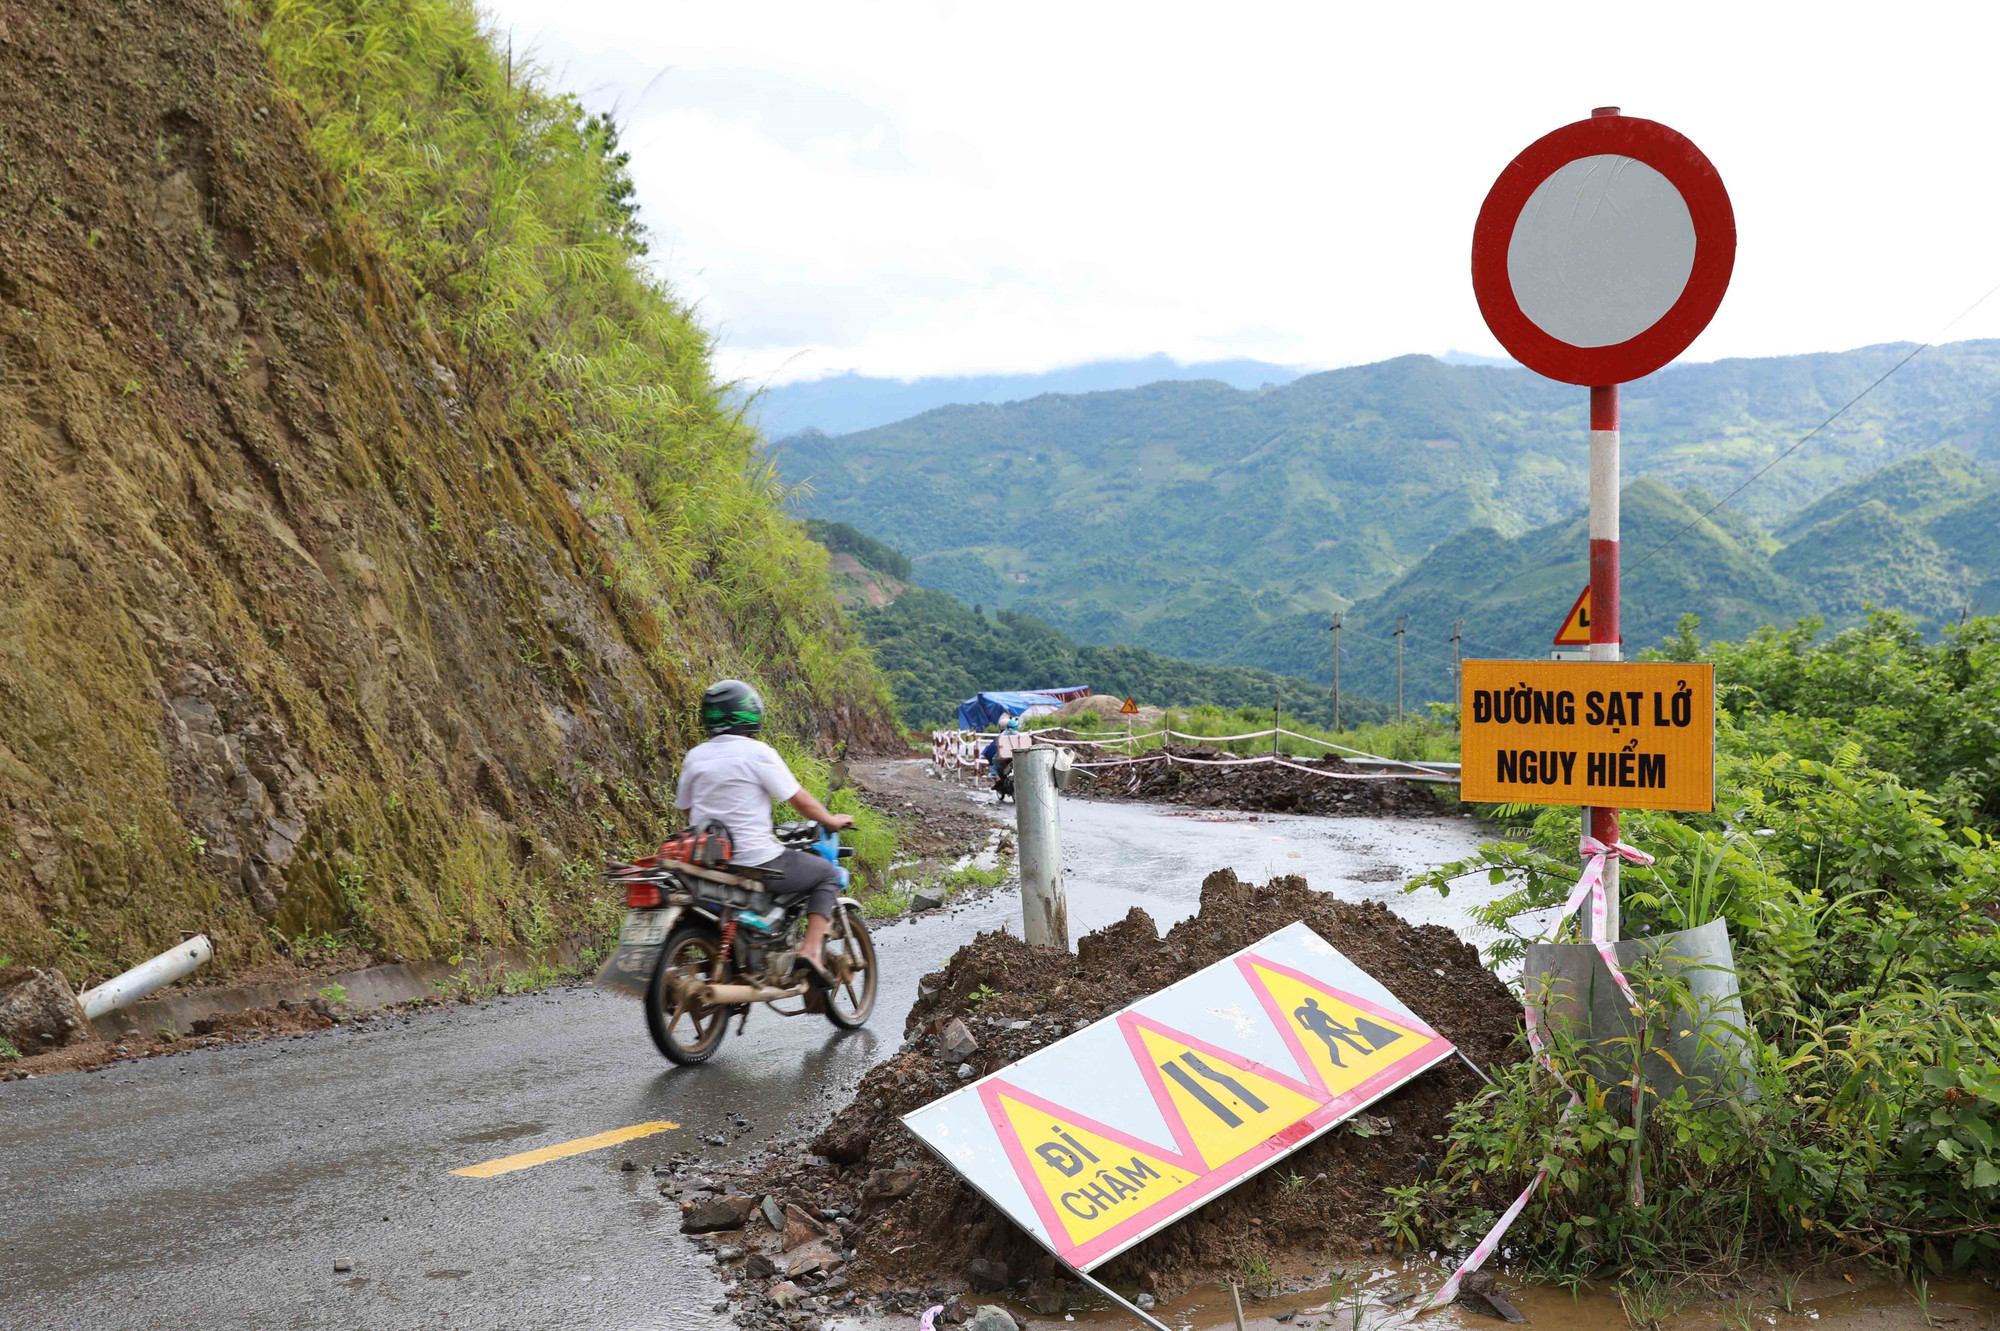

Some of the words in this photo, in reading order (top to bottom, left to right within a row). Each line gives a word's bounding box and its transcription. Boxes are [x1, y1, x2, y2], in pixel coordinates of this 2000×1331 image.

[1473, 682, 1575, 725] ĐƯỜNG
[1586, 690, 1643, 734] SẠT
[1654, 679, 1692, 728] LỞ
[1497, 749, 1577, 786] NGUY
[1587, 738, 1666, 789] HIỂM
[1060, 1156, 1162, 1221] CHẬM
